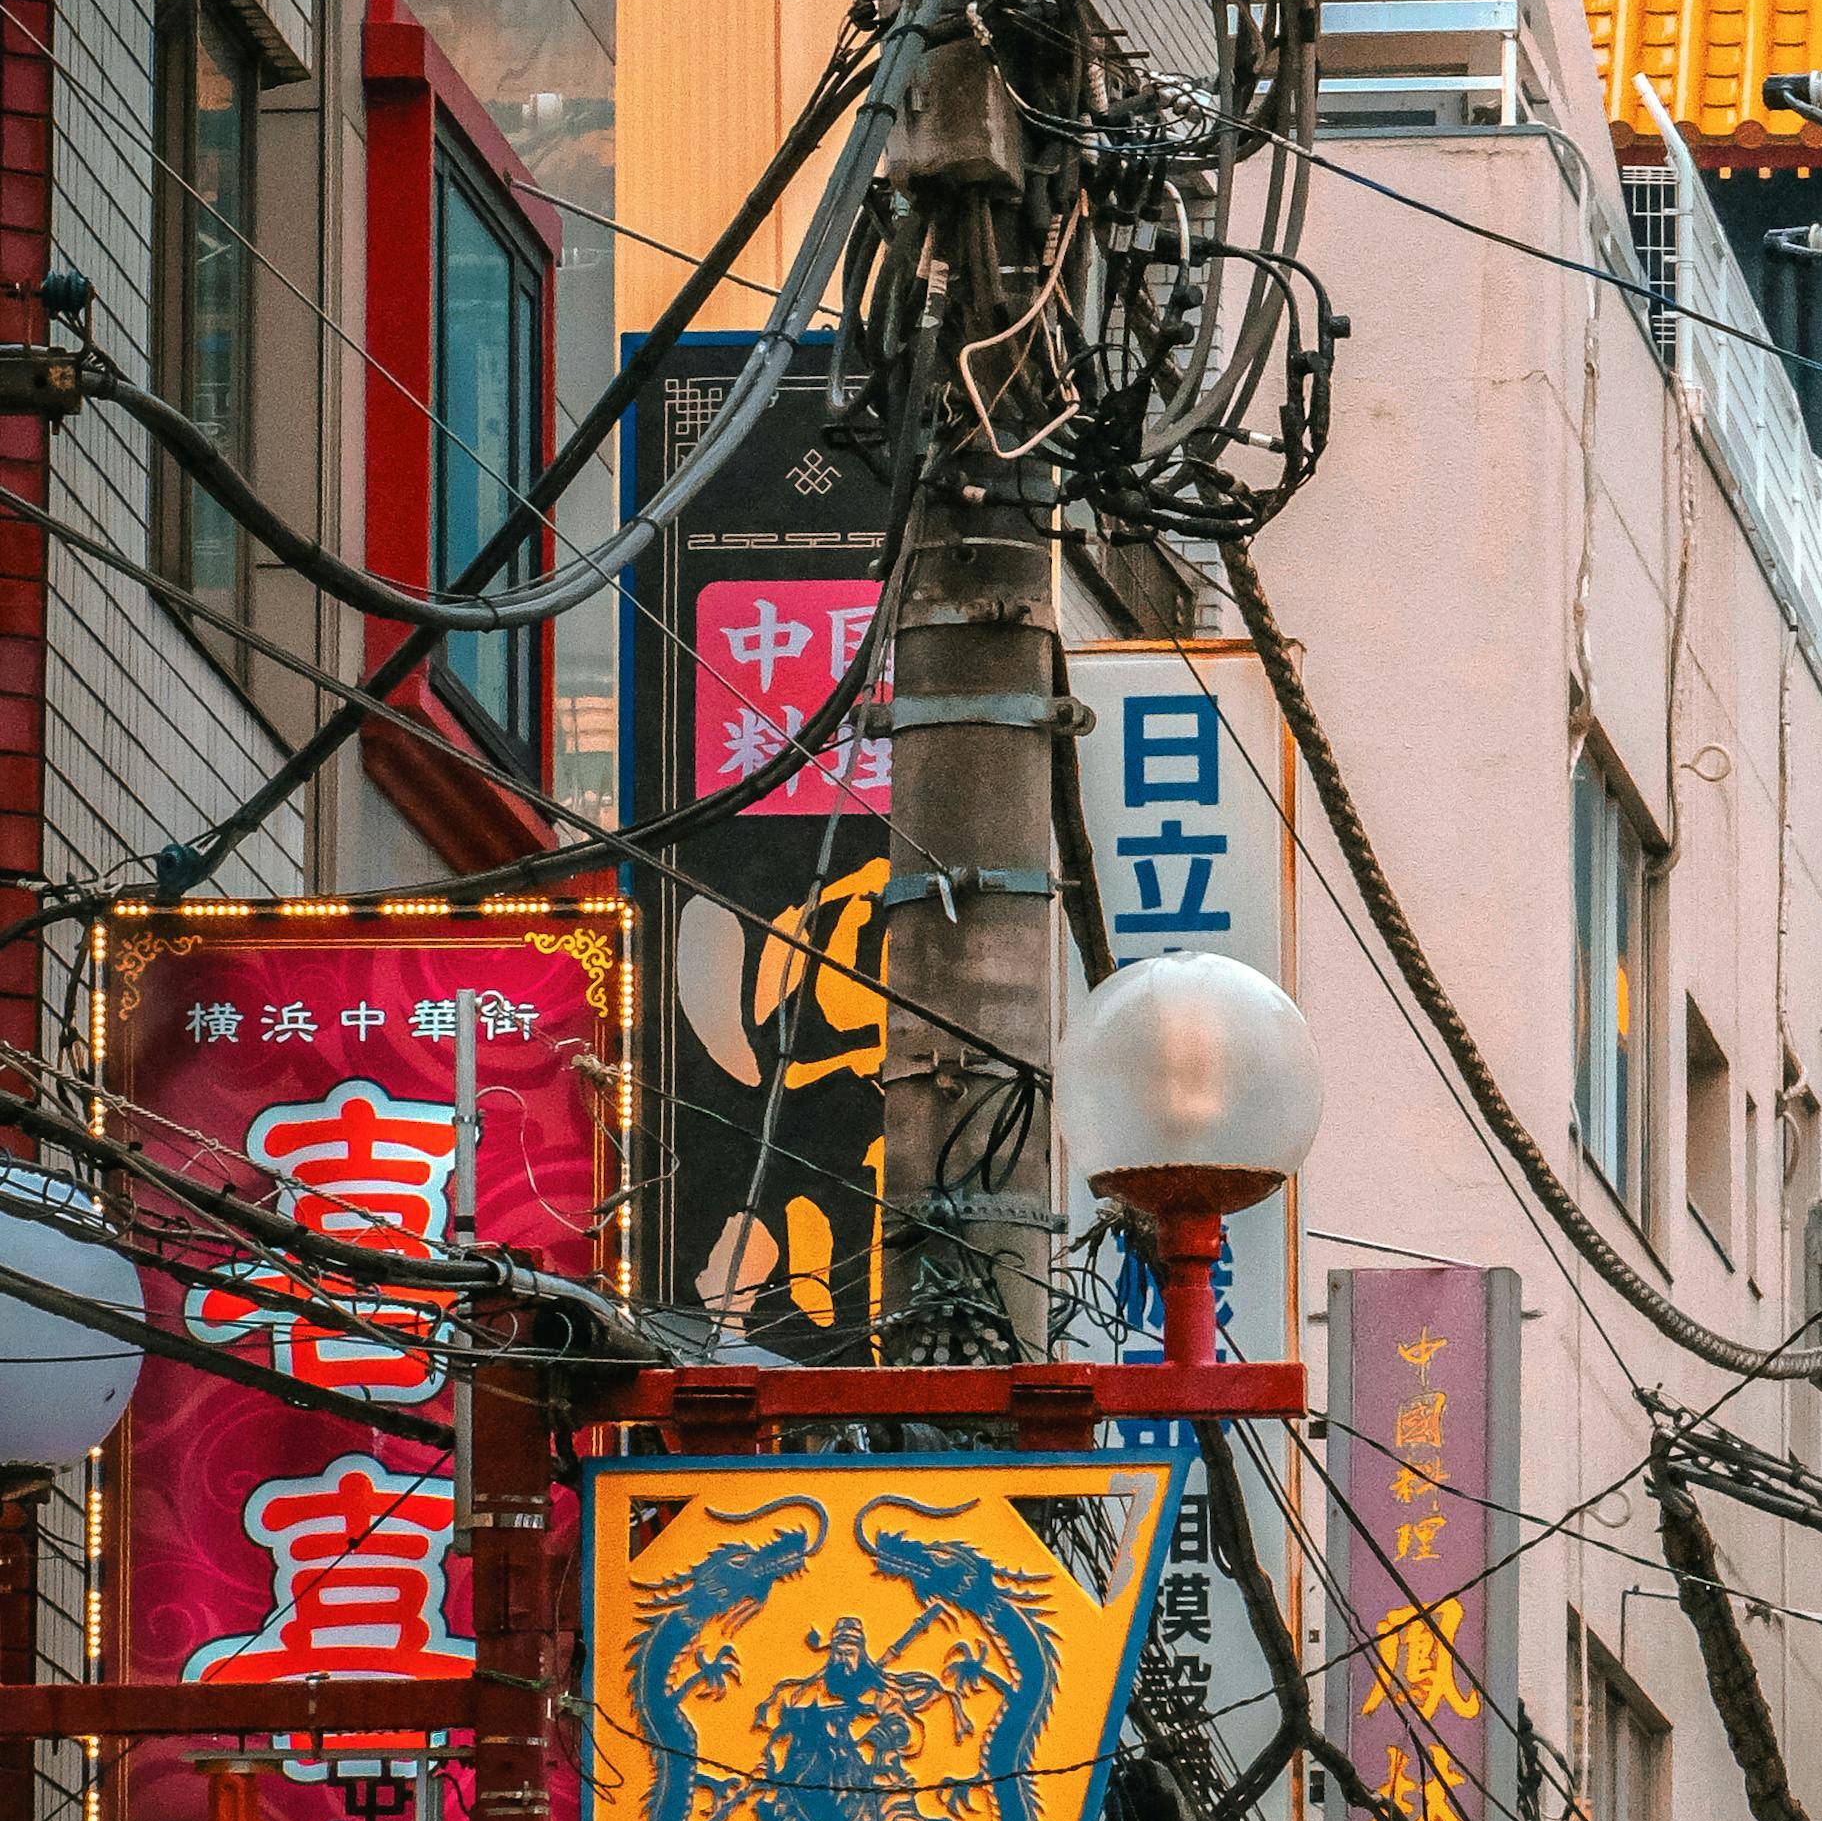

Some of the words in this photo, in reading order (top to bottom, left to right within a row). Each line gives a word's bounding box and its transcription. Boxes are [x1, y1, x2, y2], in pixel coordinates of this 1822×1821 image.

[185, 999, 542, 1044] 横浜中華街
